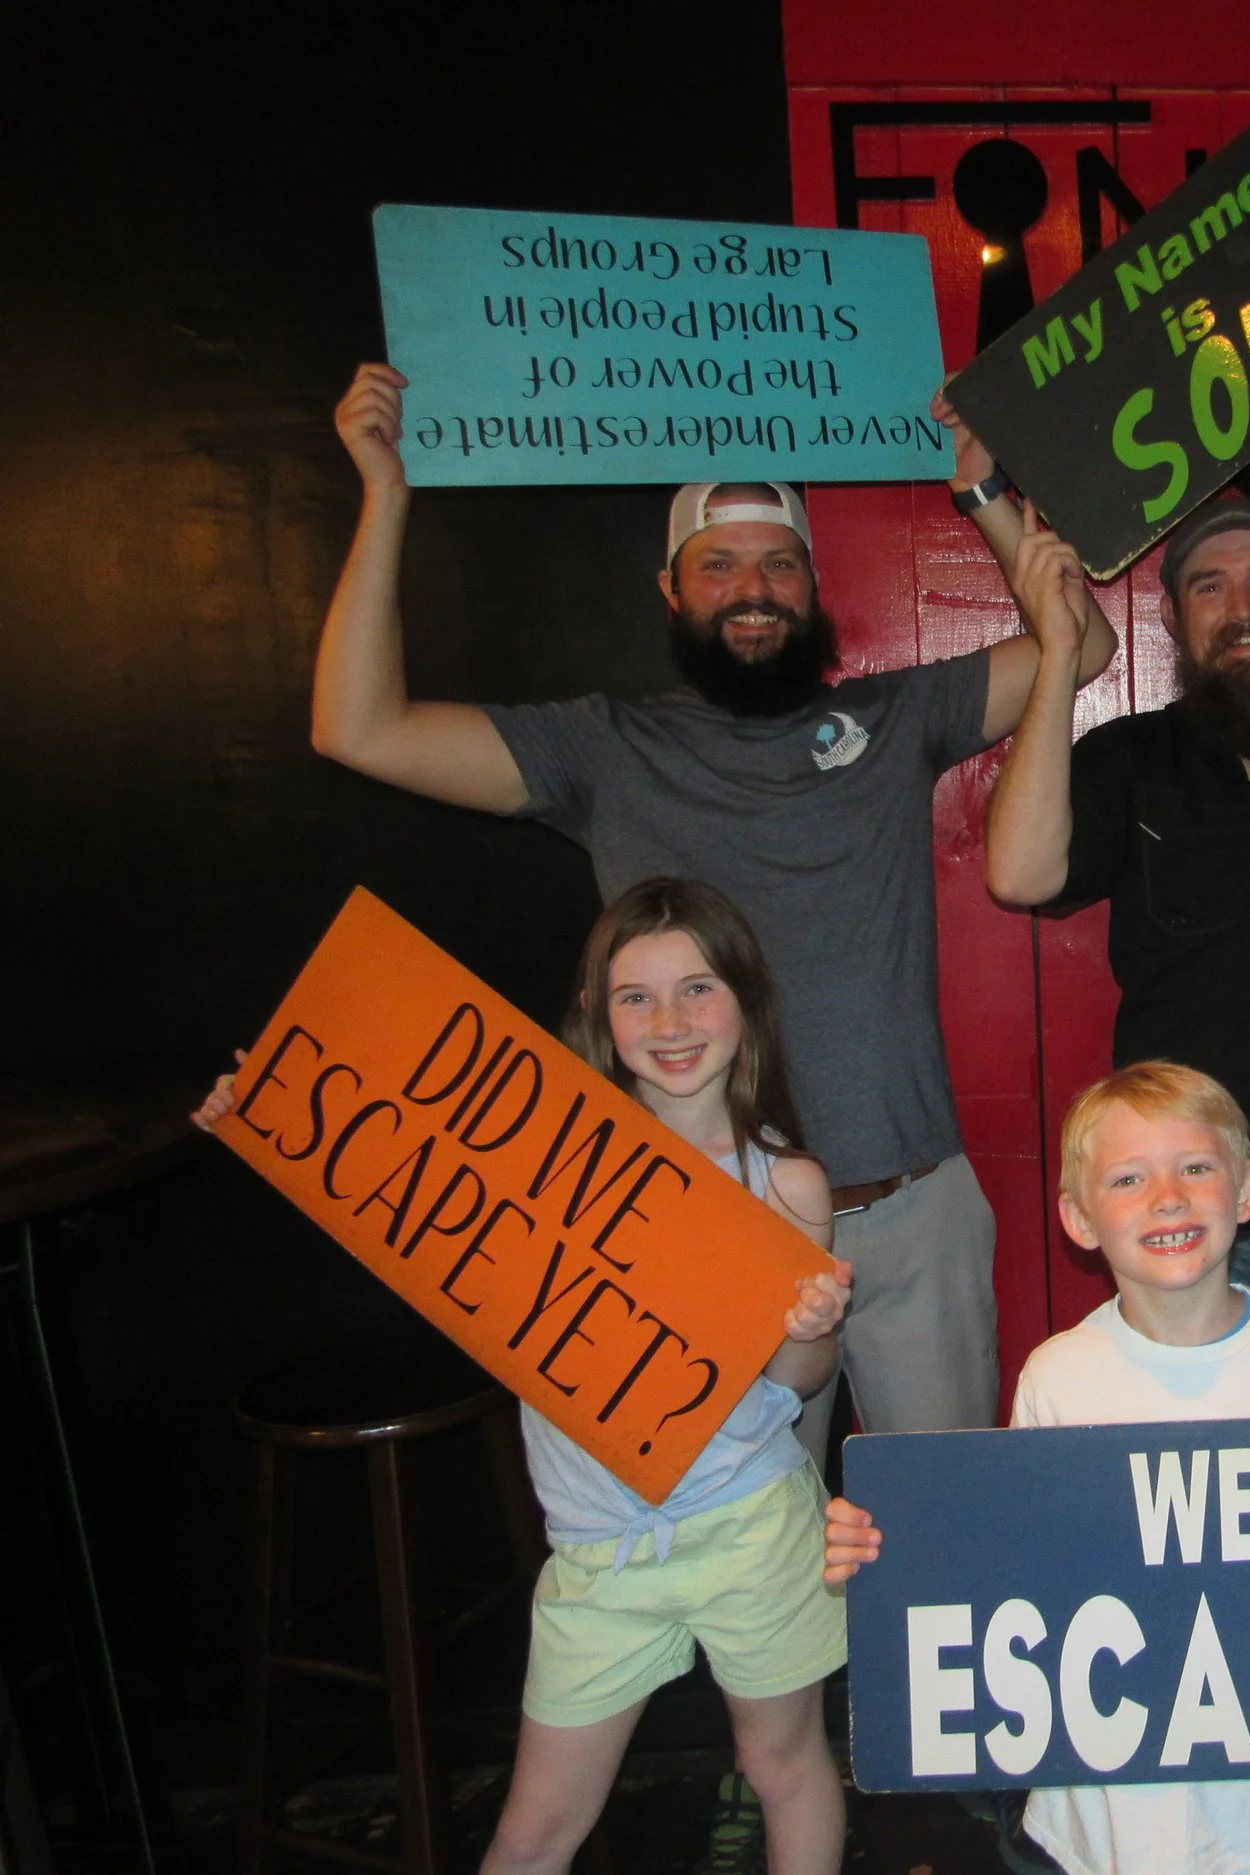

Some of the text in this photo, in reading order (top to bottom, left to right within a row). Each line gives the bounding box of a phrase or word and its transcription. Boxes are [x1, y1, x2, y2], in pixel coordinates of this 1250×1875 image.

[500, 226, 833, 286] Large Groups
[483, 287, 860, 343] Stupid People in
[1019, 296, 1104, 390] My
[1161, 296, 1216, 358] is
[522, 356, 842, 400] the Power of
[416, 415, 943, 457] Never Underestimate
[818, 729, 868, 768] SOUTH CAROLINA
[401, 1002, 693, 1274] DID WE
[235, 1024, 720, 1458] ESCAPE YET?
